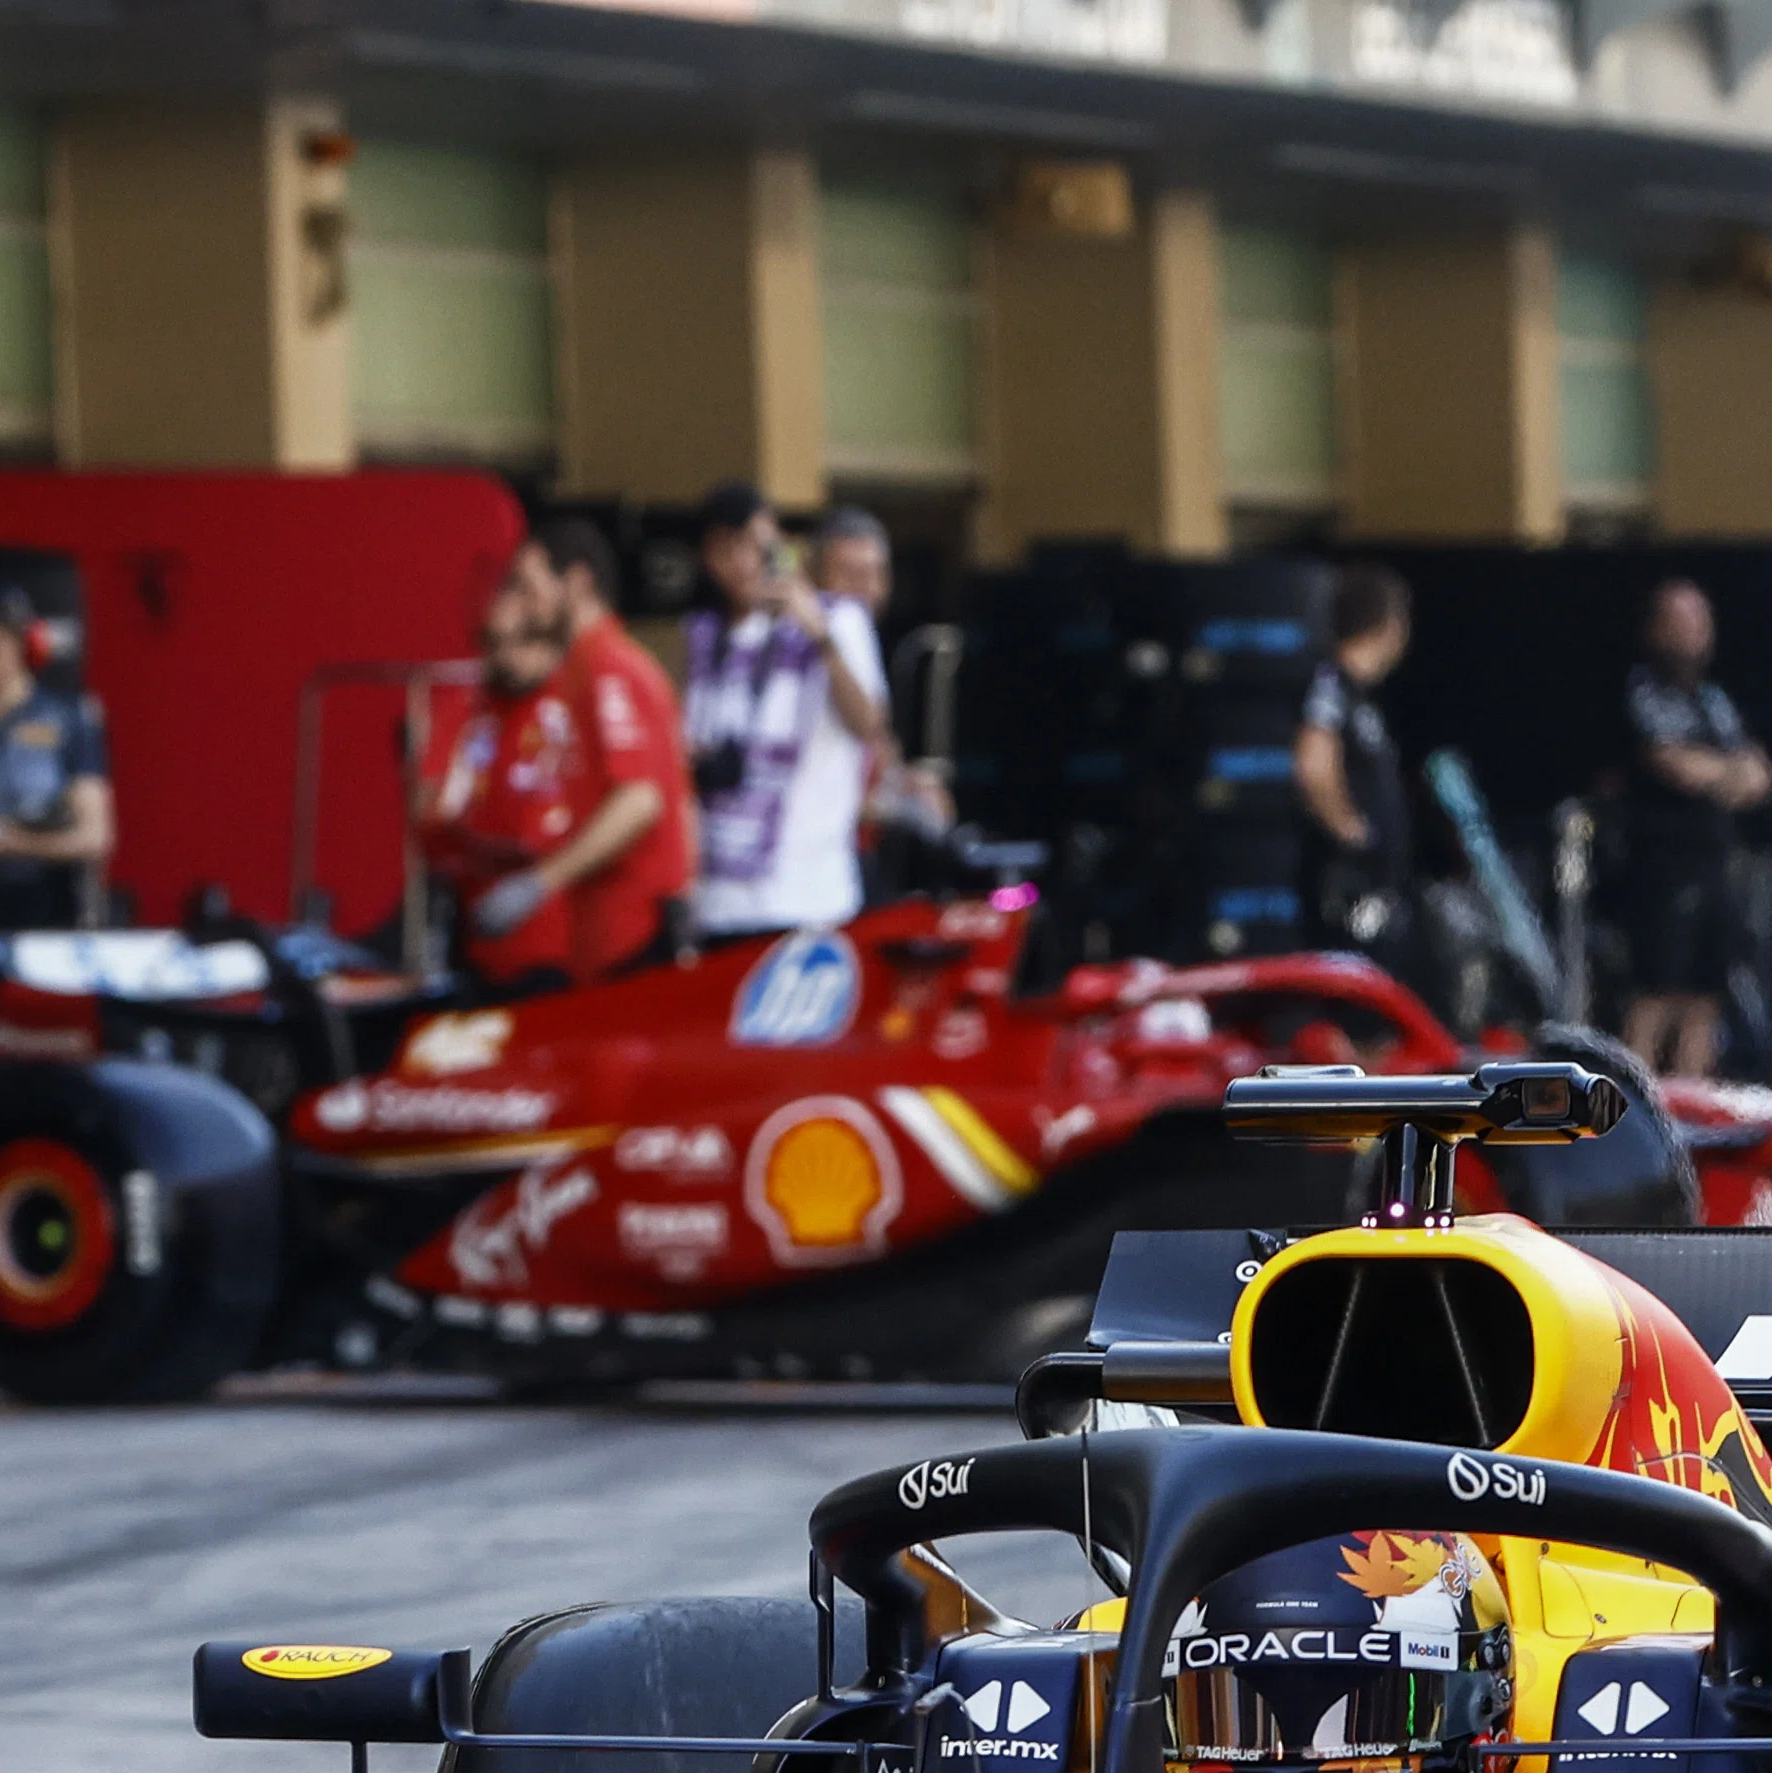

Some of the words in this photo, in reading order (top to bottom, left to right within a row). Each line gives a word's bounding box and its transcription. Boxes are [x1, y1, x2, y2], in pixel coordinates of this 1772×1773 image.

[929, 1457, 976, 1498] Sui
[1492, 1462, 1546, 1506] Sui
[279, 1649, 370, 1663] RAUCH
[1184, 1630, 1392, 1668] ORACLE
[1407, 1641, 1439, 1658] Mobil
[939, 1734, 1060, 1761] inter.mx
